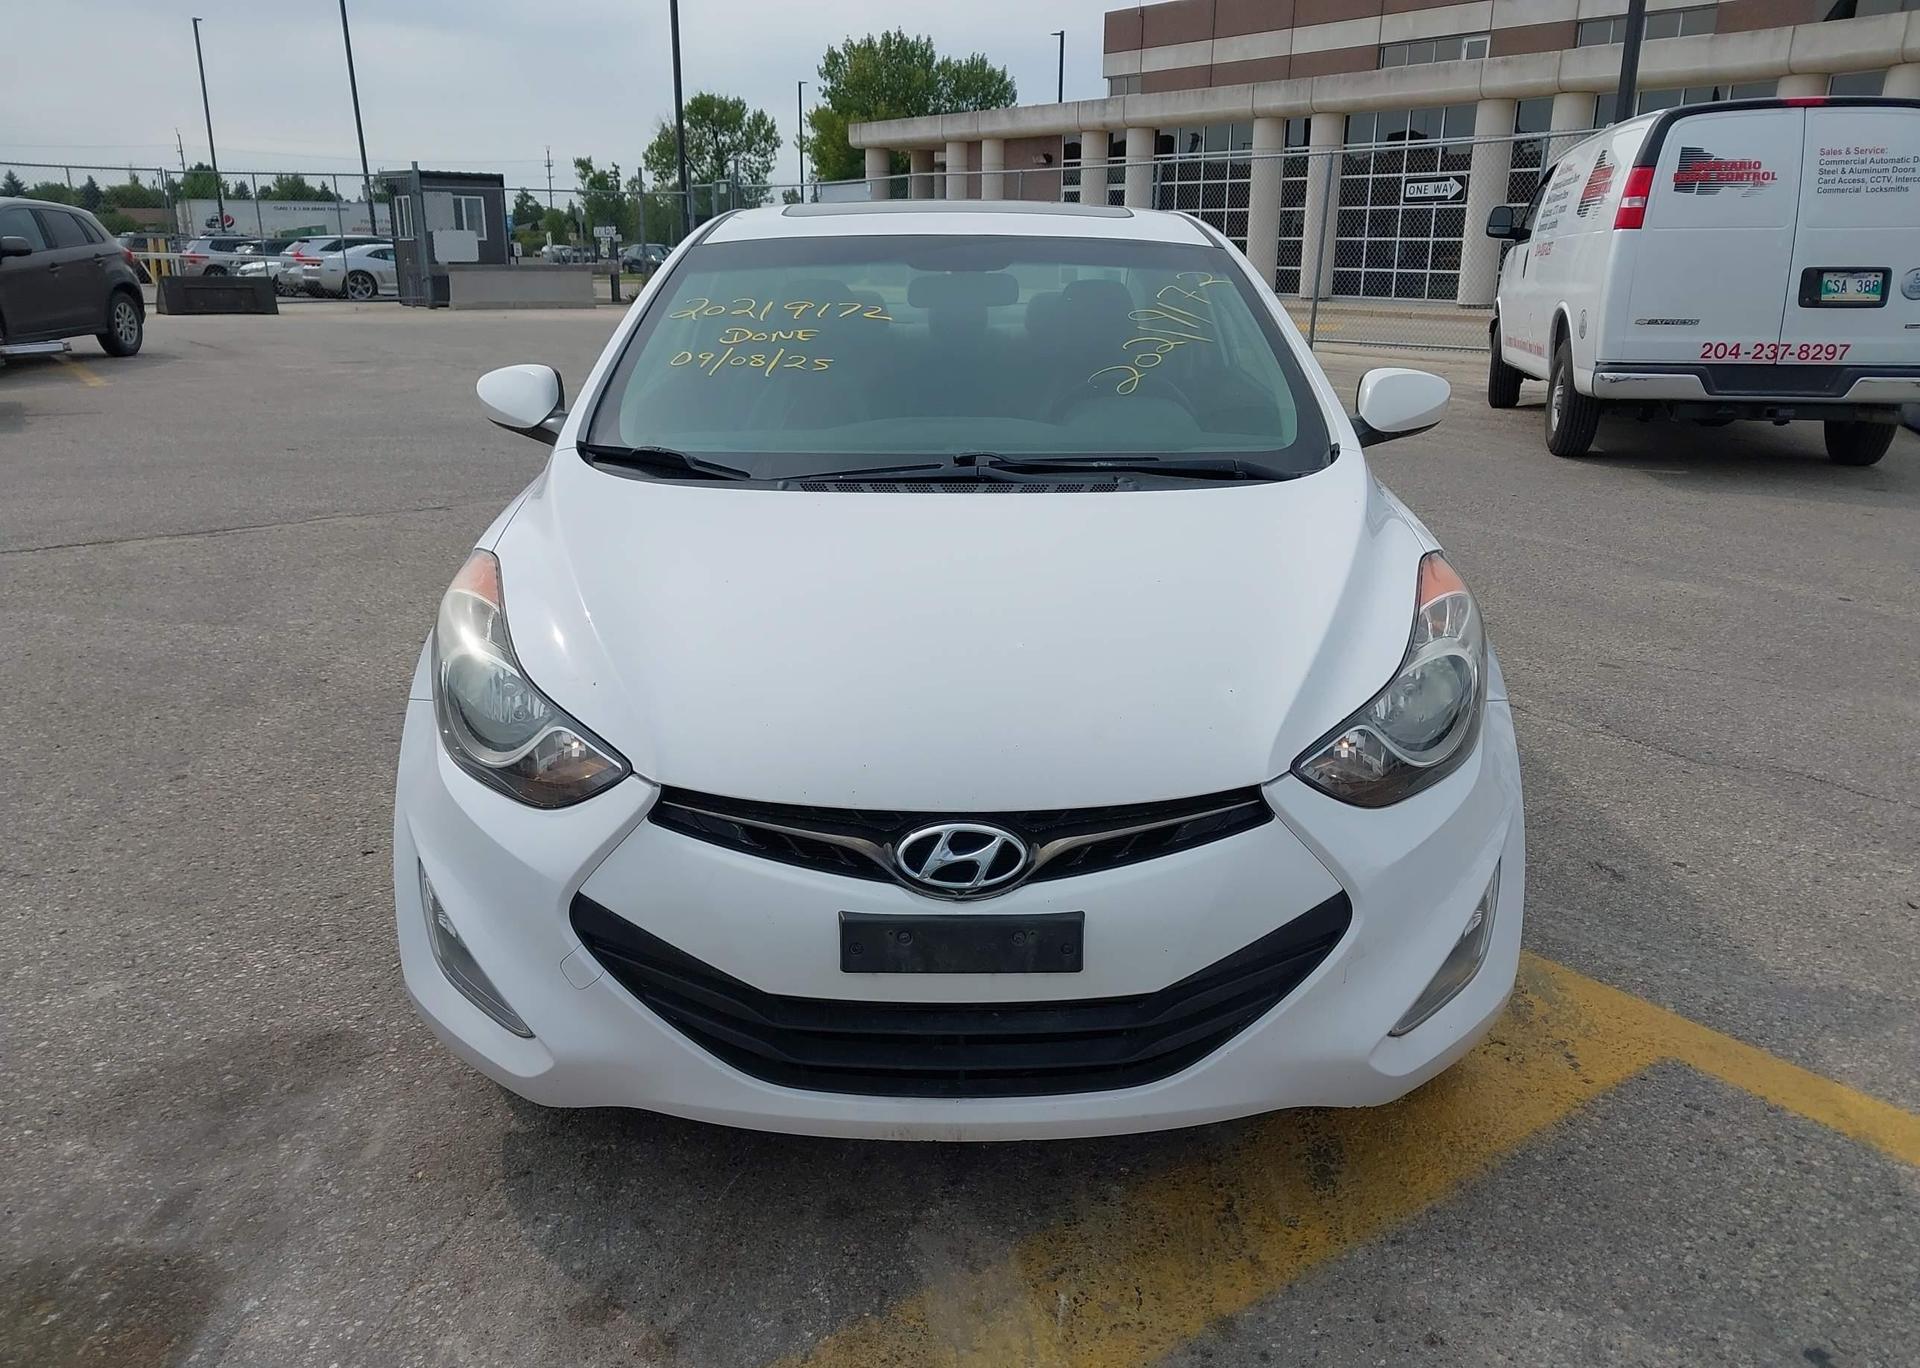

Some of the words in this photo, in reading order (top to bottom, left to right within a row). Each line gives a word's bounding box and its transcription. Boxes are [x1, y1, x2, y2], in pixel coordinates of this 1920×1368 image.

[1820, 148, 1843, 156] Sales
[1845, 147, 1851, 155] &
[1819, 158, 1868, 166] Commercial
[1869, 156, 1911, 165] Automatic
[1818, 167, 1839, 175] Steel
[1841, 167, 1847, 175] &
[1848, 167, 1890, 175] Aluminum
[1891, 166, 1916, 174] Doors
[1716, 171, 1778, 182] CONTROL
[1818, 177, 1836, 185] Card
[1837, 177, 1867, 185] Access,
[1408, 184, 1429, 195] ONE
[1433, 183, 1455, 194] WAY
[1817, 186, 1862, 194] Commercial
[1865, 185, 1910, 193] Locksmiths
[1825, 280, 1847, 293] CSA
[1856, 280, 1879, 293] 388
[719, 327, 820, 344] DONE
[1700, 342, 1851, 360] 204-237-8297
[670, 347, 835, 377] 09/08/25
